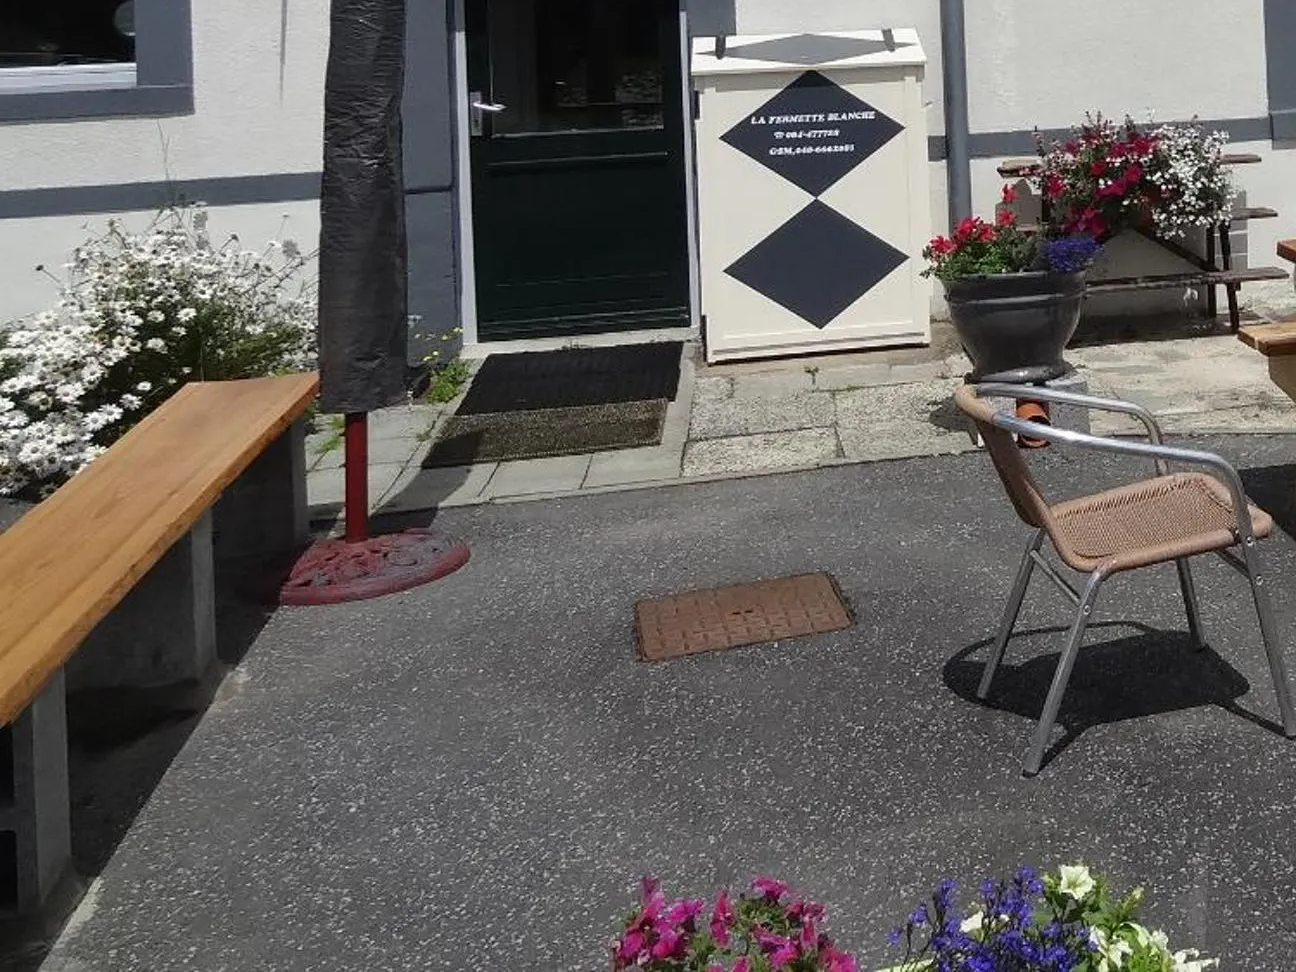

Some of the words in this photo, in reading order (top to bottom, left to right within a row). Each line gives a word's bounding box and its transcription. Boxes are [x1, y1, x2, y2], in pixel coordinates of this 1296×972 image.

[750, 115, 767, 125] LA
[768, 114, 825, 124] FERMETTE
[827, 111, 876, 121] BLANCHE
